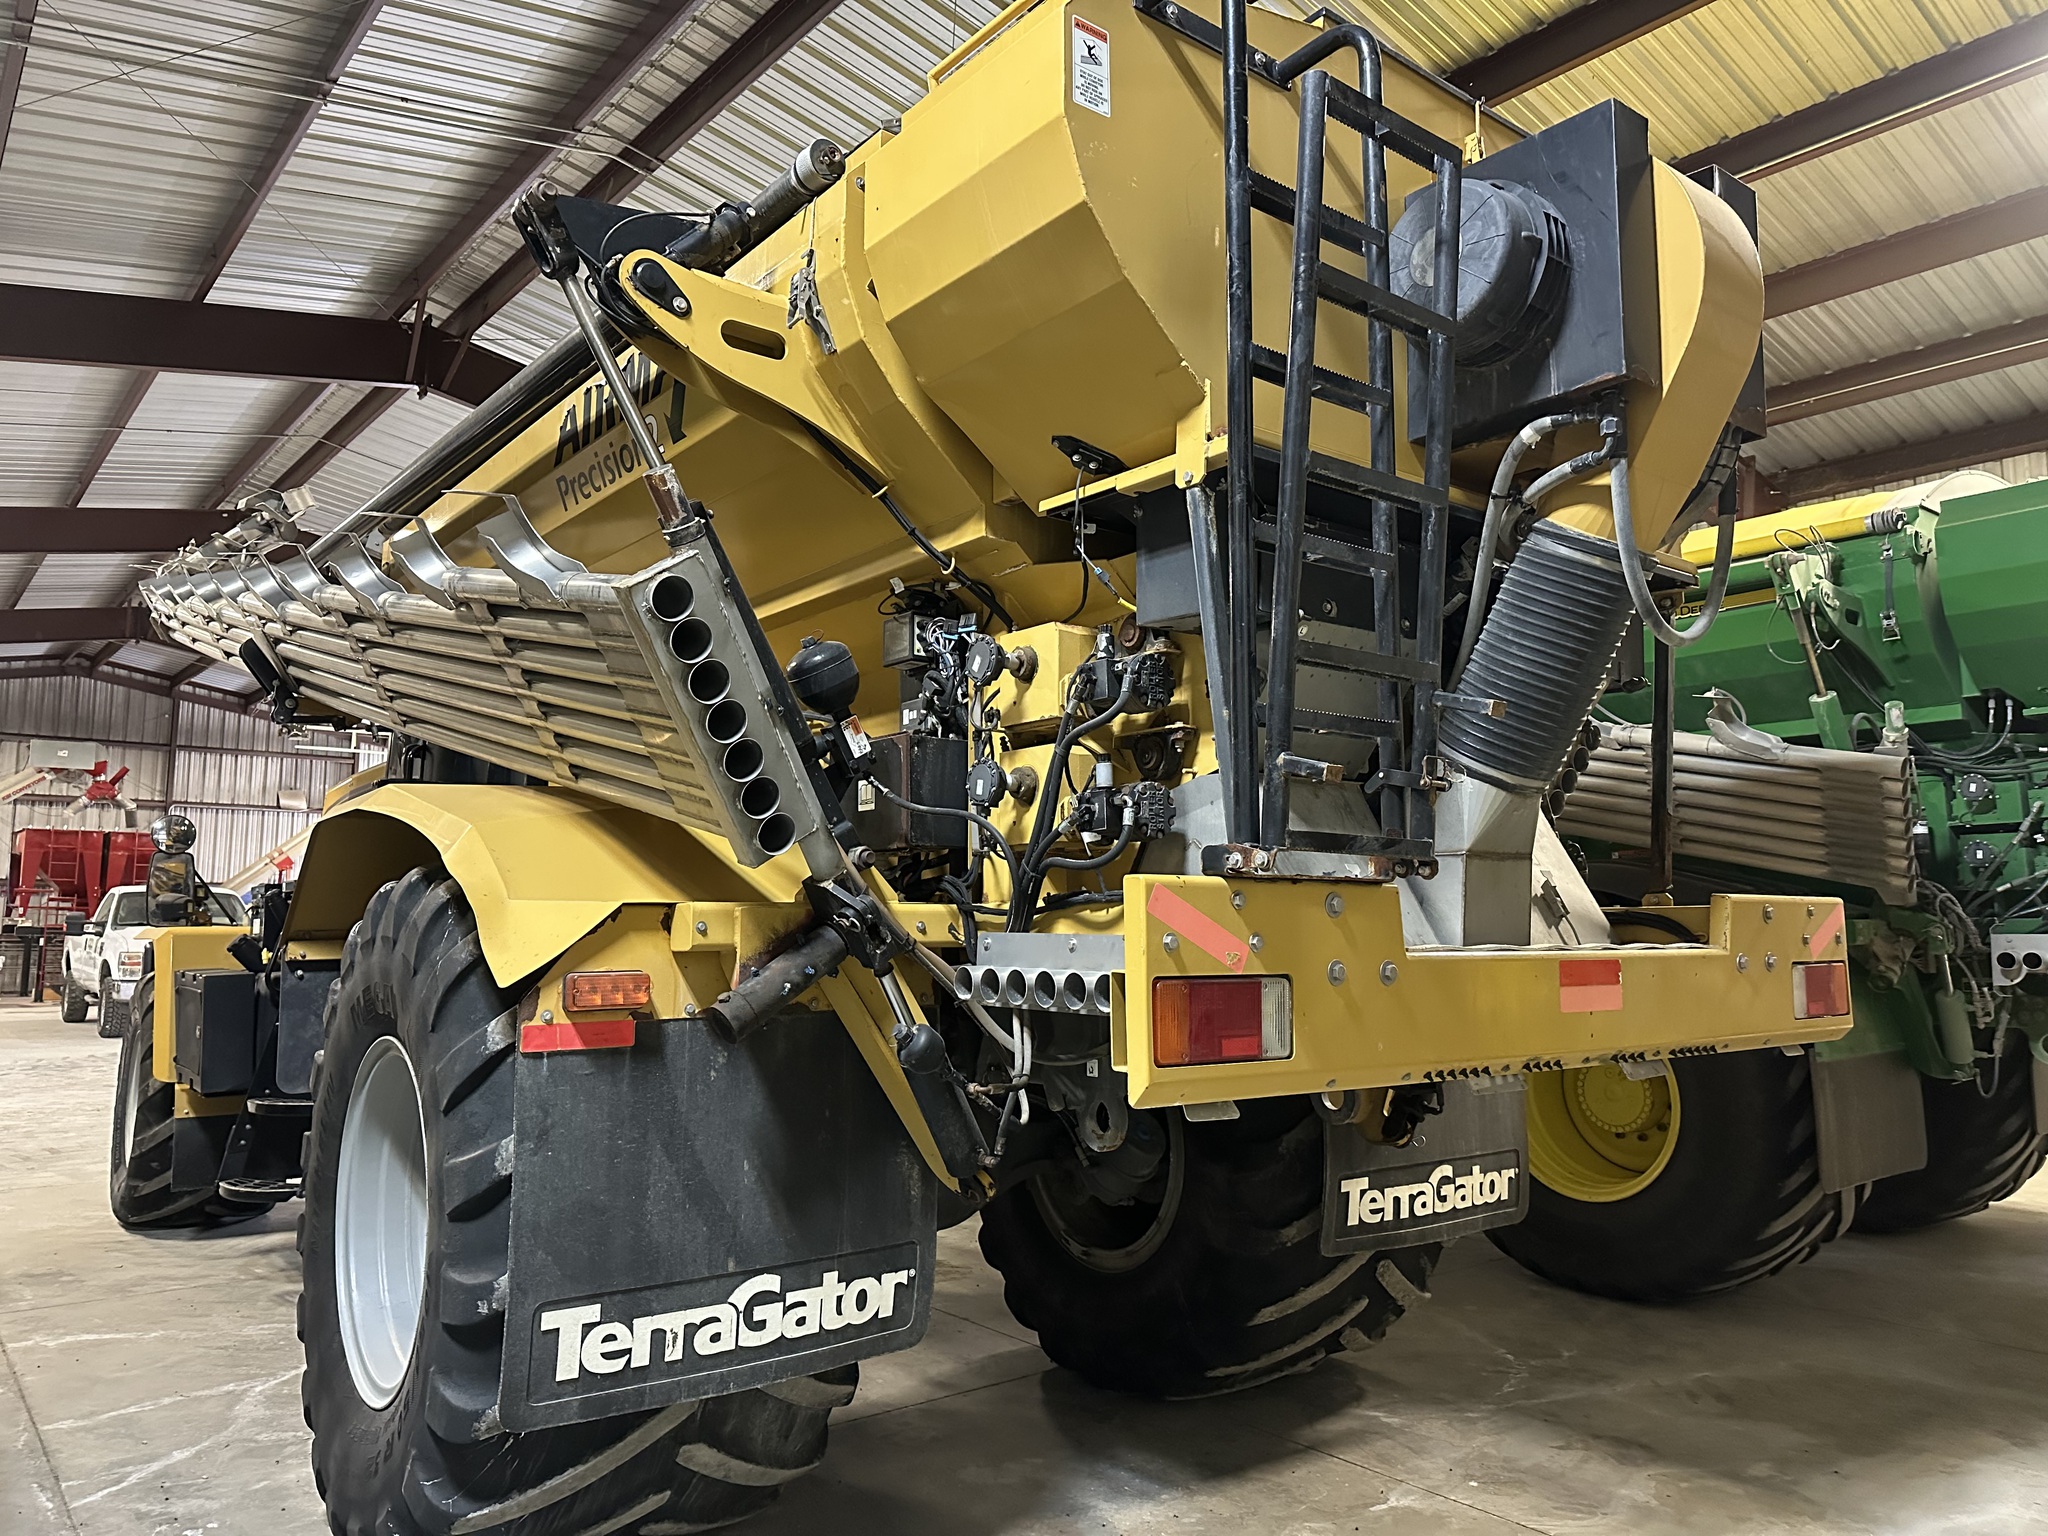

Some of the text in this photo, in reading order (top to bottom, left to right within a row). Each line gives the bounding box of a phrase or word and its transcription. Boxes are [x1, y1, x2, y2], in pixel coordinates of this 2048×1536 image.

[1148, 790, 1157, 830] ROLLER
[1156, 790, 1165, 830] STATOR
[1340, 1164, 1516, 1227] TerraGator
[539, 1271, 909, 1383] TerraGator
